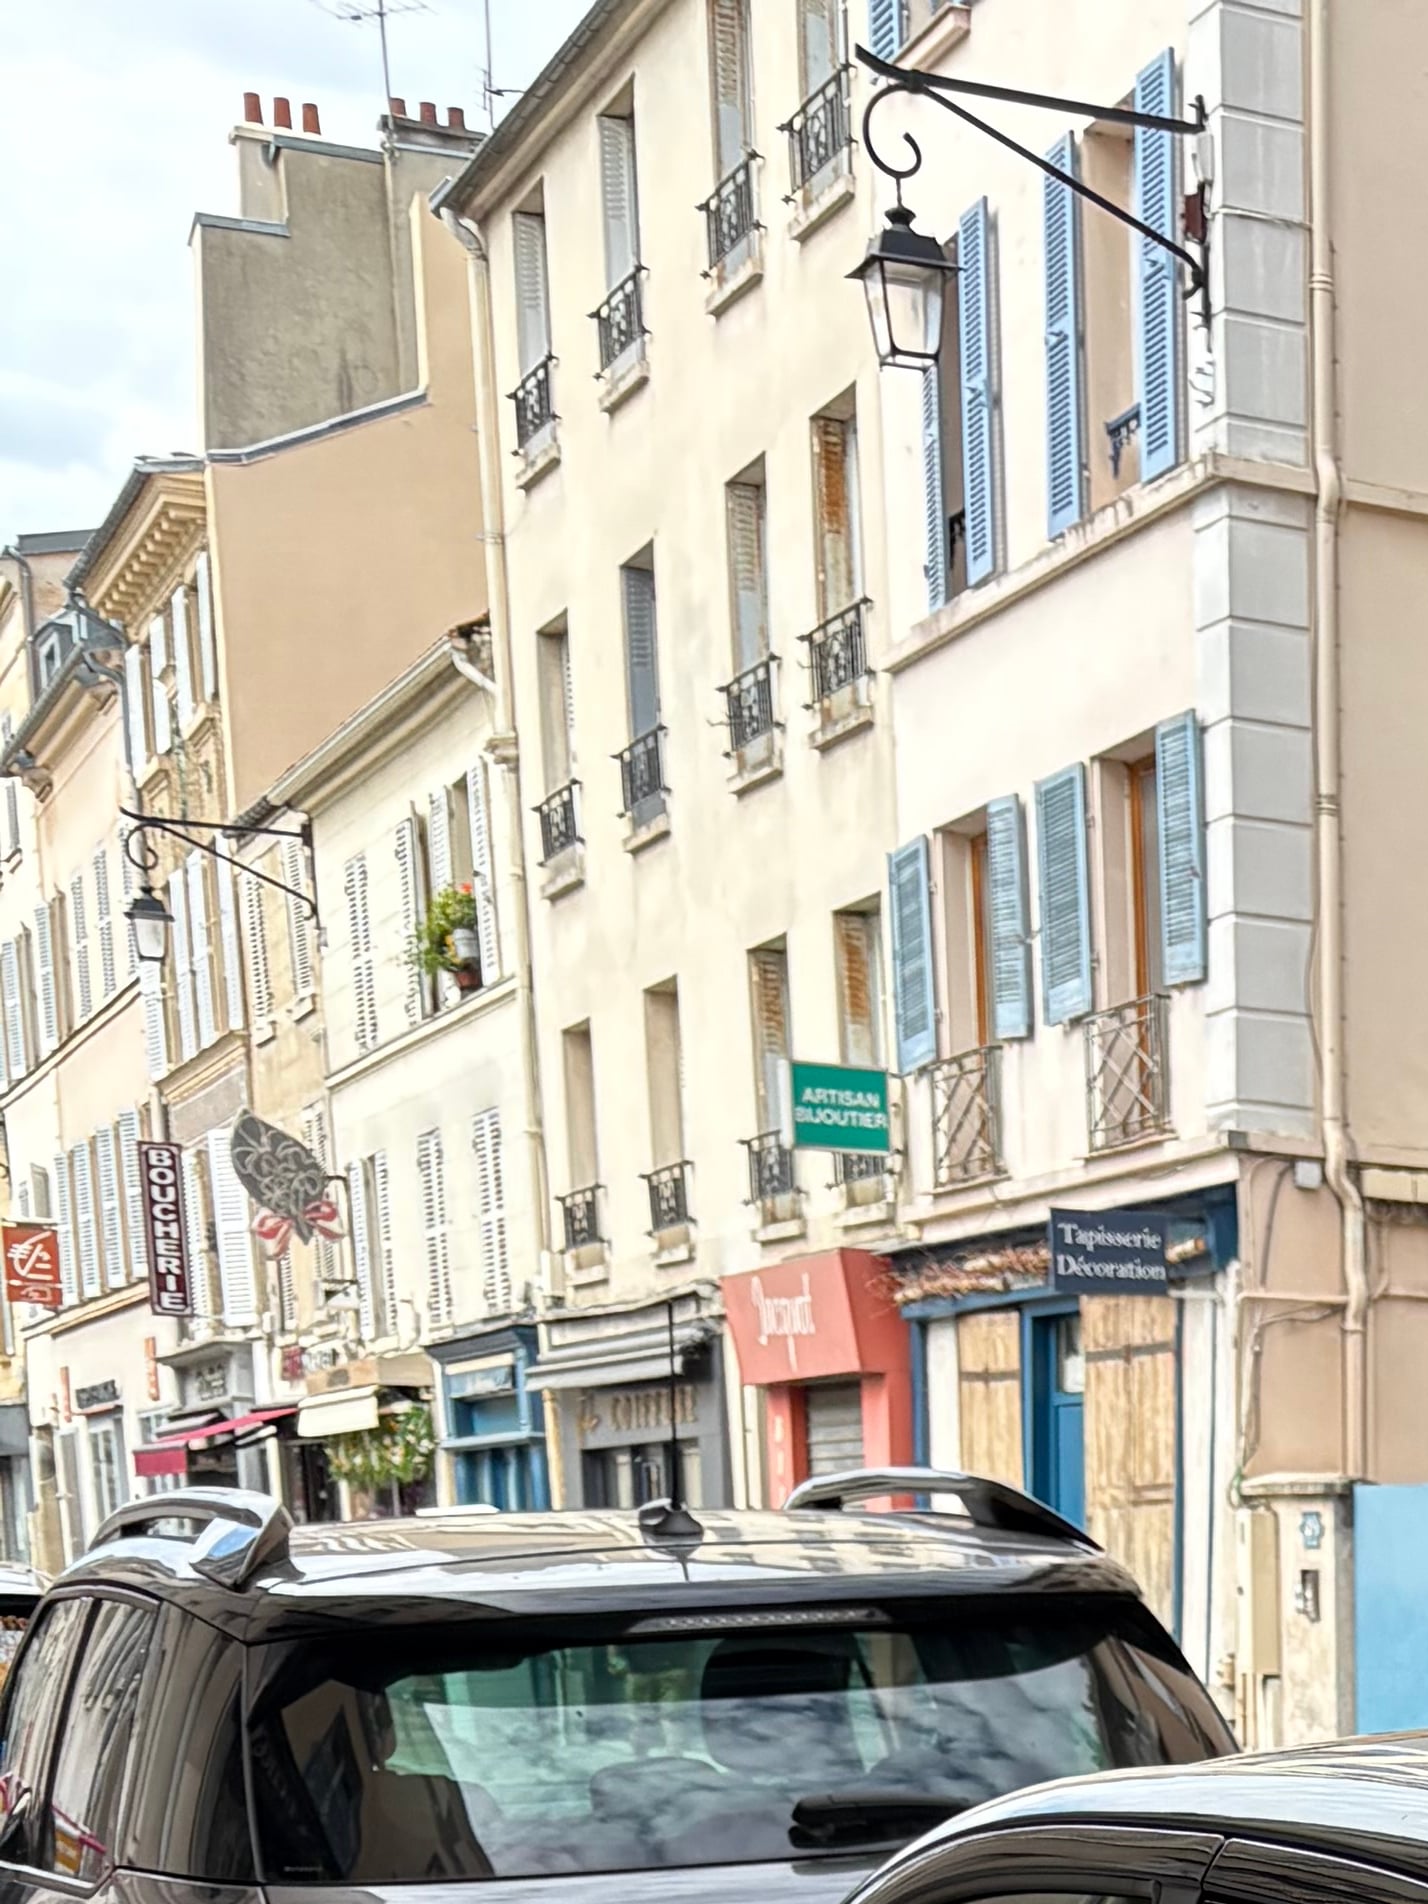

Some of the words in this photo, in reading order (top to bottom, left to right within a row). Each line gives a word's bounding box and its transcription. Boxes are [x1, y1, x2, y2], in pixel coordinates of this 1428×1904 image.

[801, 1086, 880, 1110] ARTISAN
[795, 1106, 888, 1130] BIJOUTIER
[147, 1149, 186, 1310] BOUCHERIE
[1056, 1222, 1162, 1252] Tapisserie
[1056, 1253, 1167, 1282] Décoration
